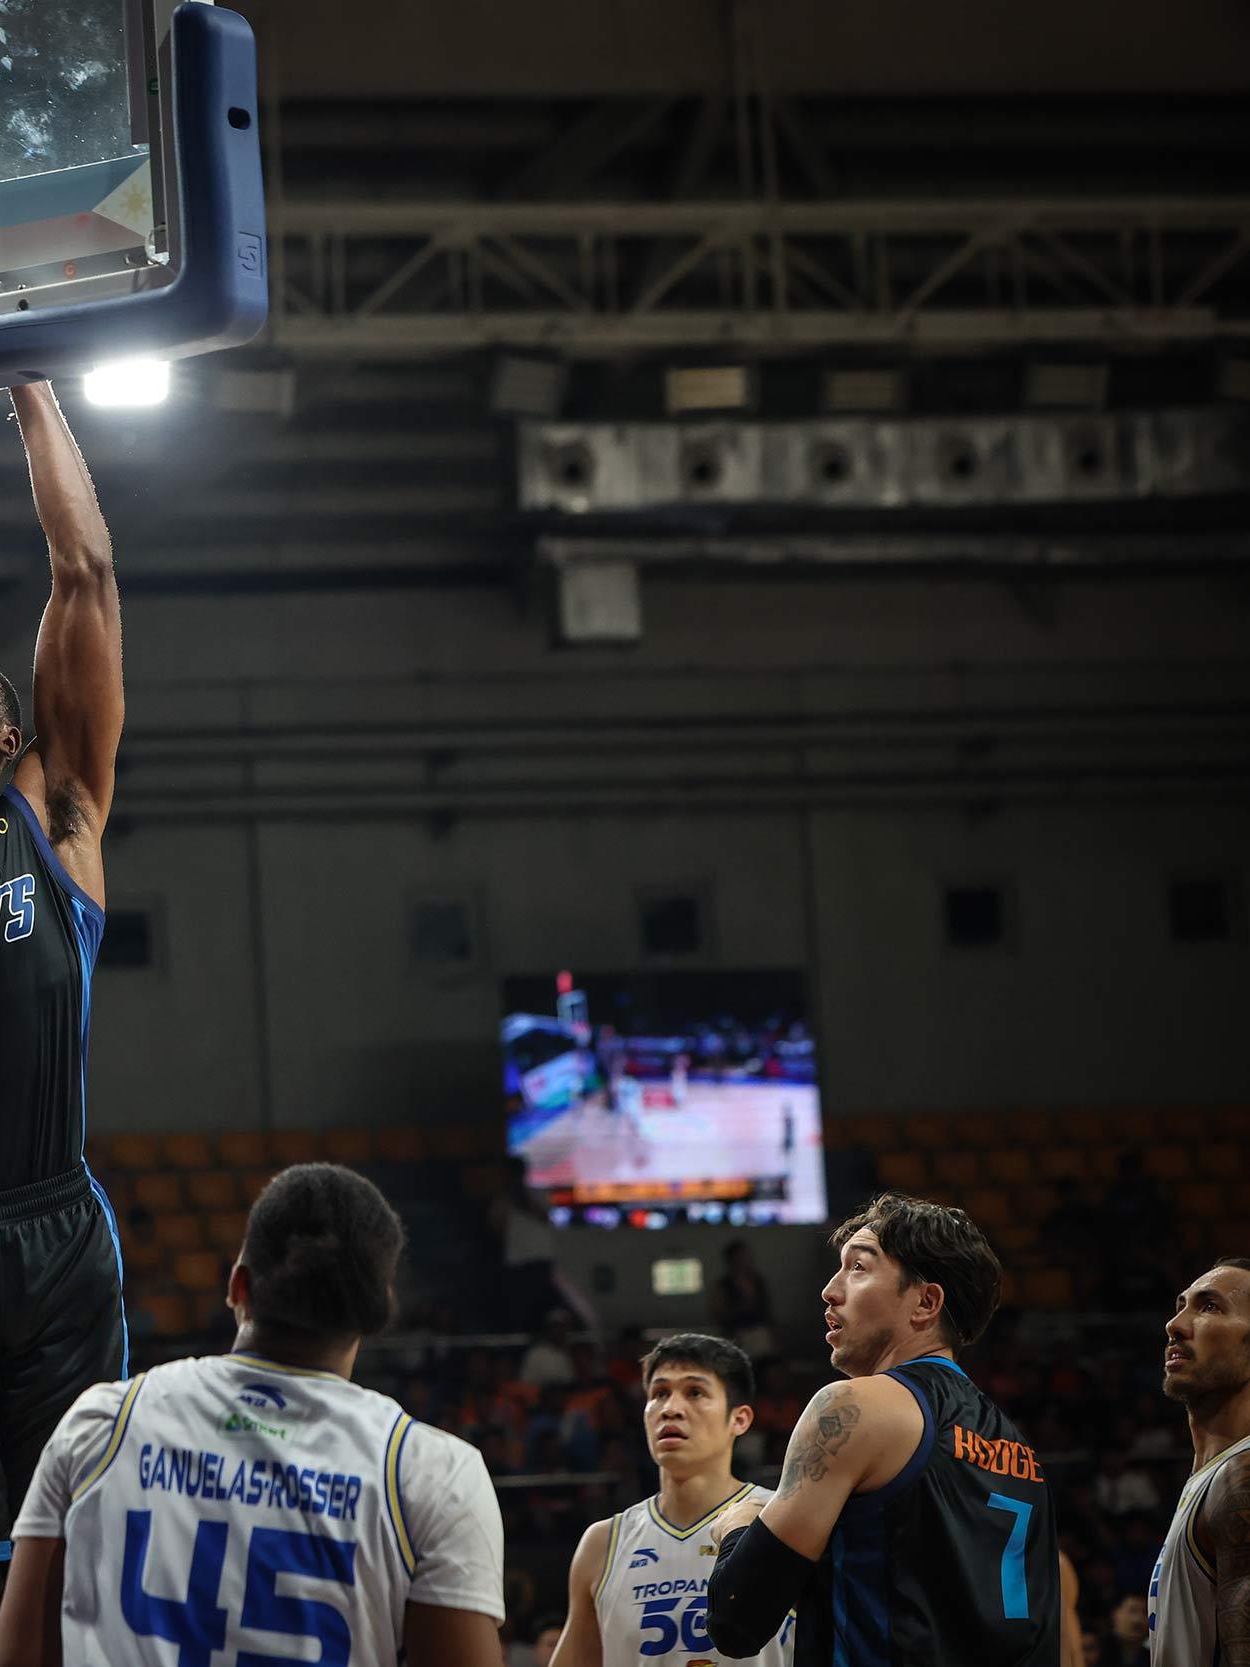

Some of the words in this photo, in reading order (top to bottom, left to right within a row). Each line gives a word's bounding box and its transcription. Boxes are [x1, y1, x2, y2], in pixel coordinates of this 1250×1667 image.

[139, 1444, 362, 1521] GANUELAS-ROSSER
[954, 1424, 1044, 1483] HODGE
[120, 1509, 358, 1667] 45
[632, 1578, 710, 1600] TROPAN
[986, 1491, 1034, 1620] 7
